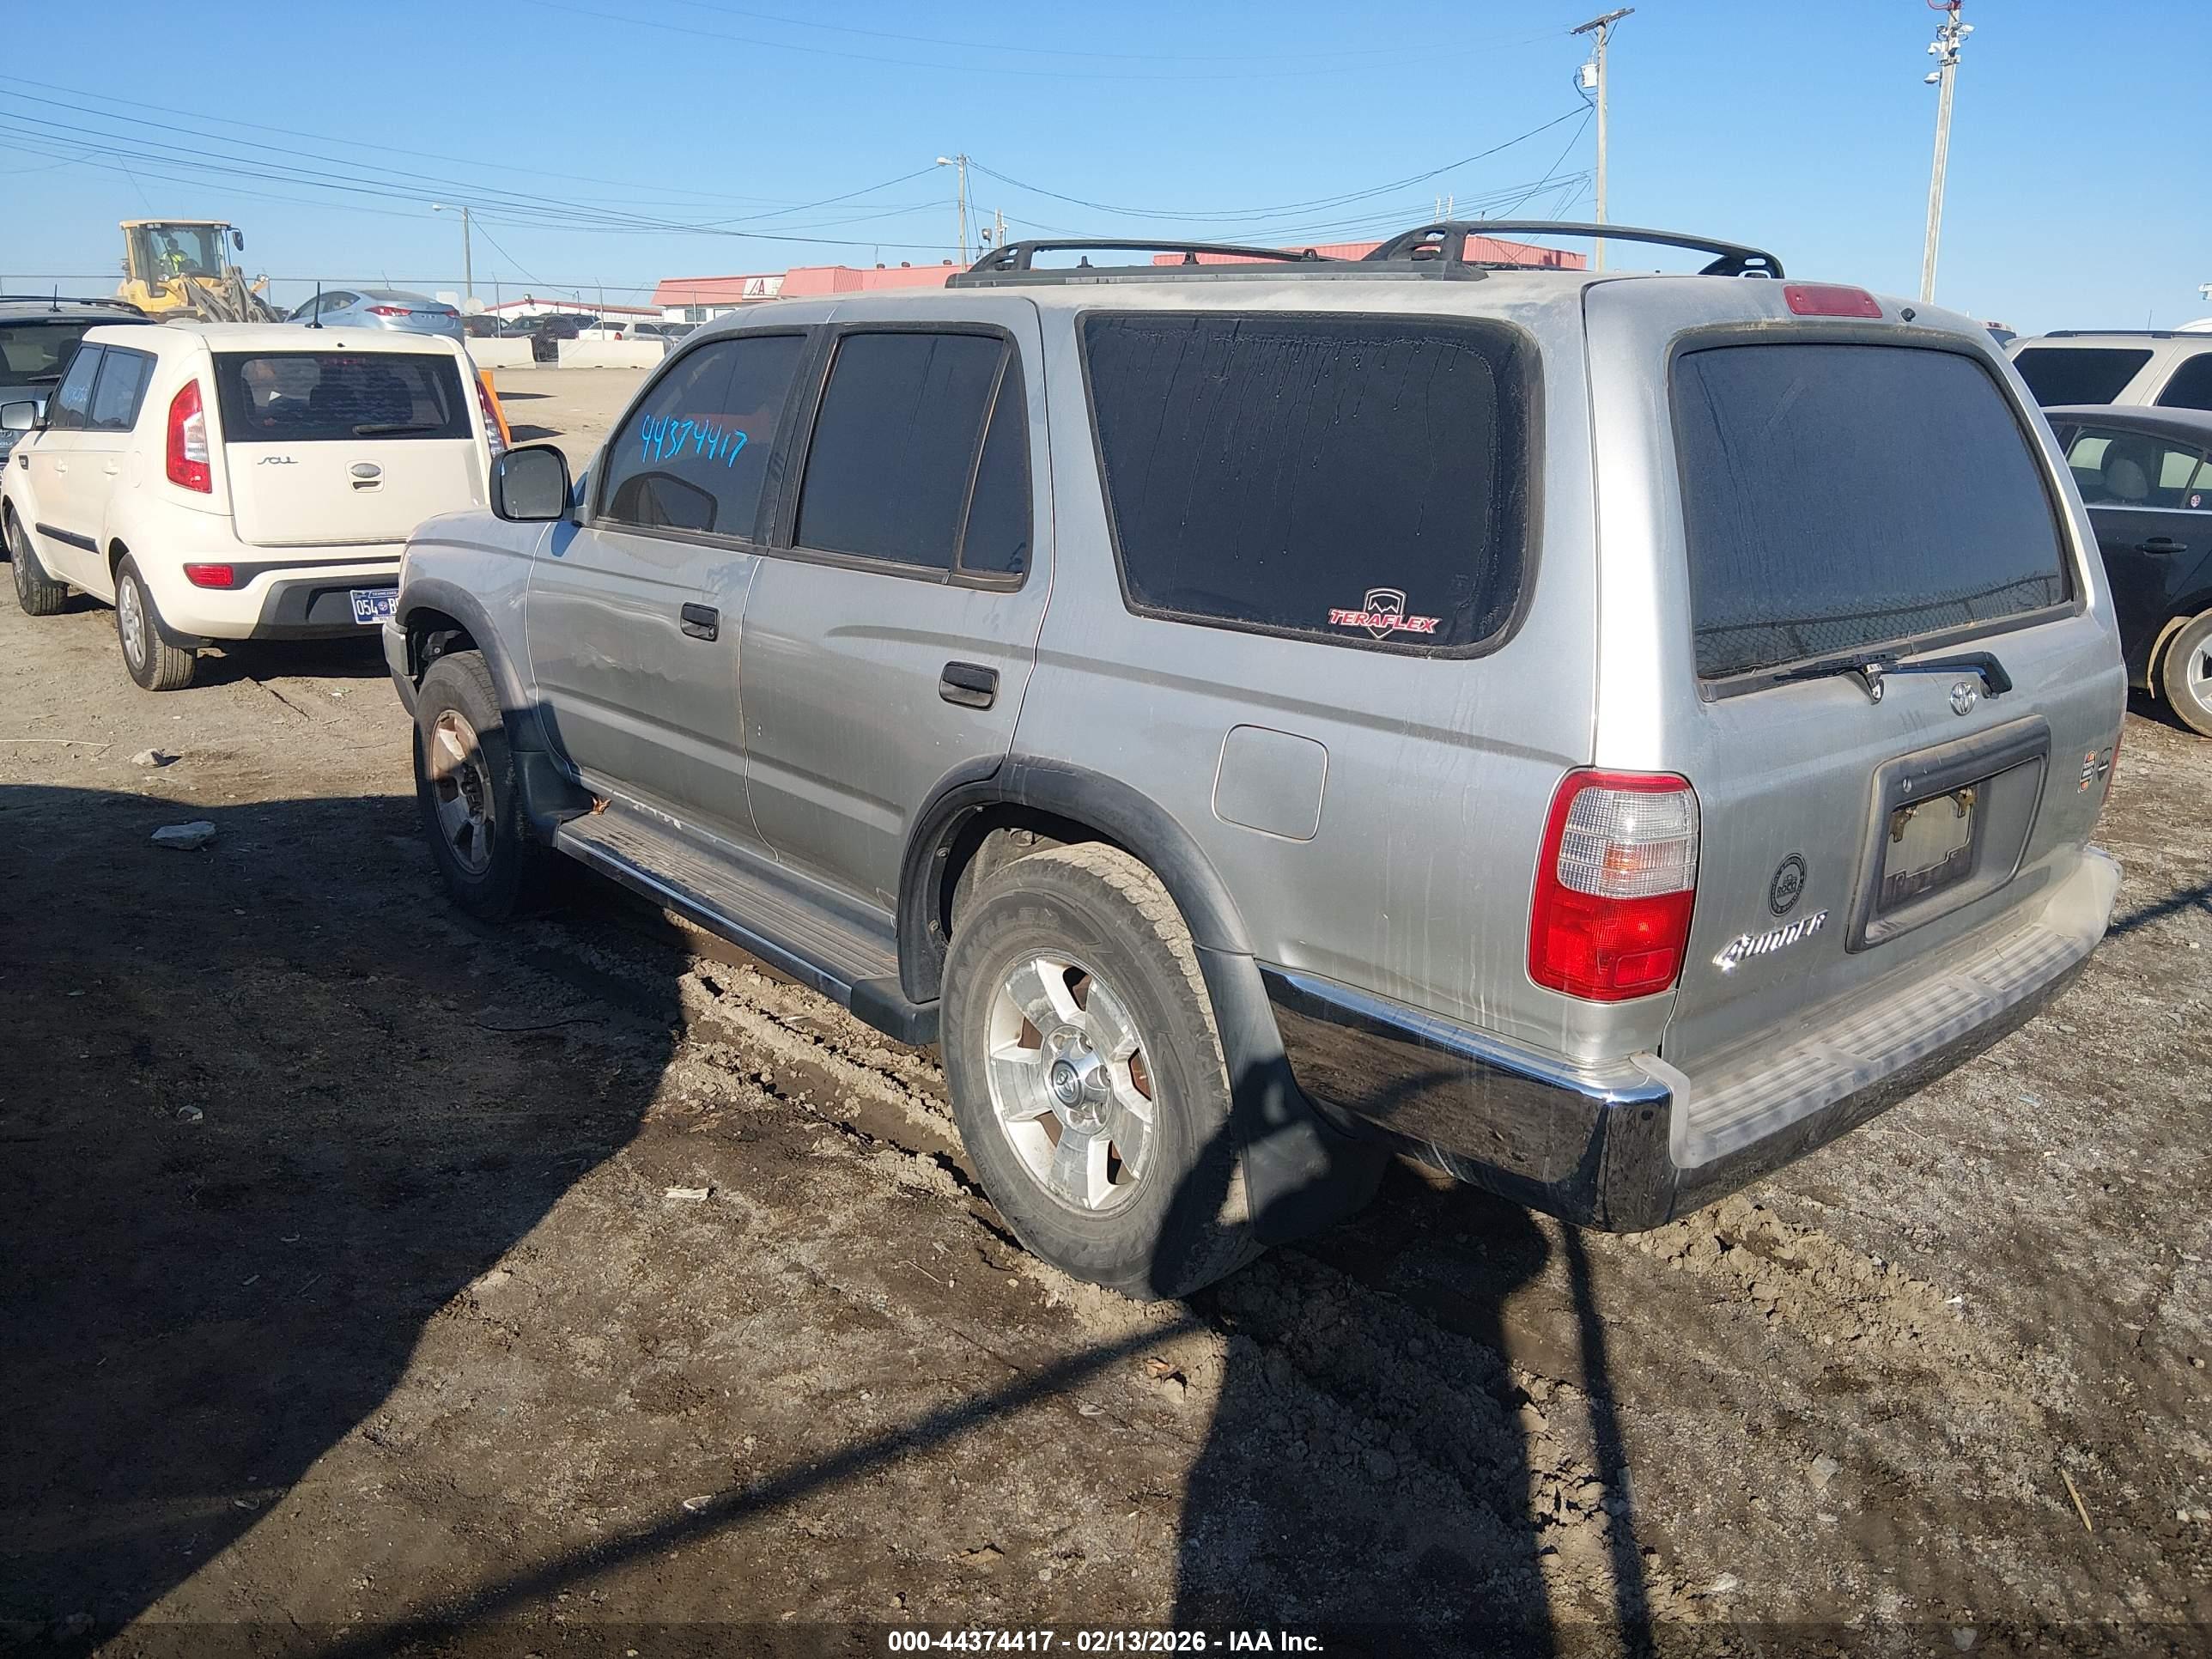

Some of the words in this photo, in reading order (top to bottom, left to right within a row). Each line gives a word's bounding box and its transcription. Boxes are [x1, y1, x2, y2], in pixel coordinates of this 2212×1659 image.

[641, 414, 748, 468] 44374417
[356, 599, 379, 616] 054
[1328, 609, 1440, 634] TERAFLEX
